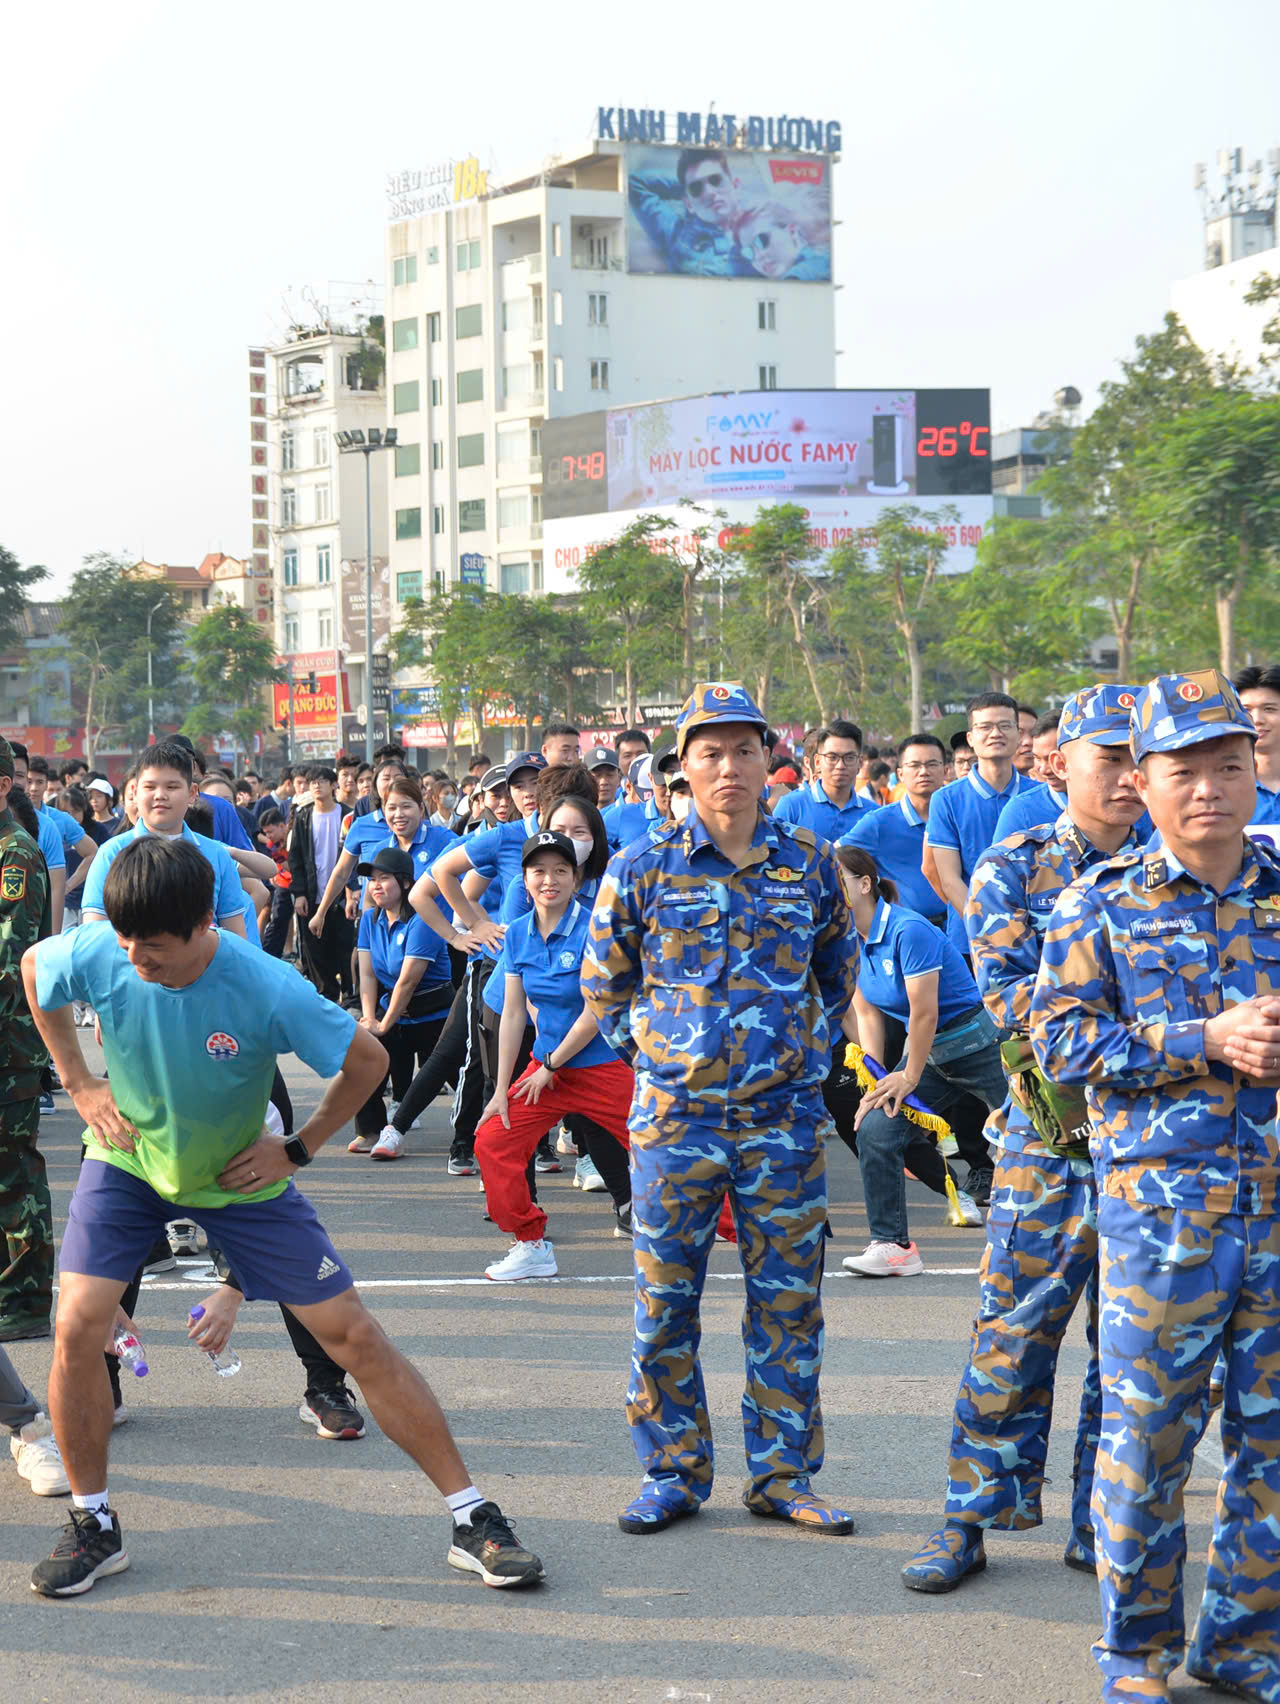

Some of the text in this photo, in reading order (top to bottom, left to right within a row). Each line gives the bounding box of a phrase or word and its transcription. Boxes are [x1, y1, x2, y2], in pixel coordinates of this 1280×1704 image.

[730, 438, 793, 464] NƯỚC
[801, 442, 858, 464] FAMY
[555, 548, 580, 569] CHO
[317, 1264, 341, 1281] adidas
